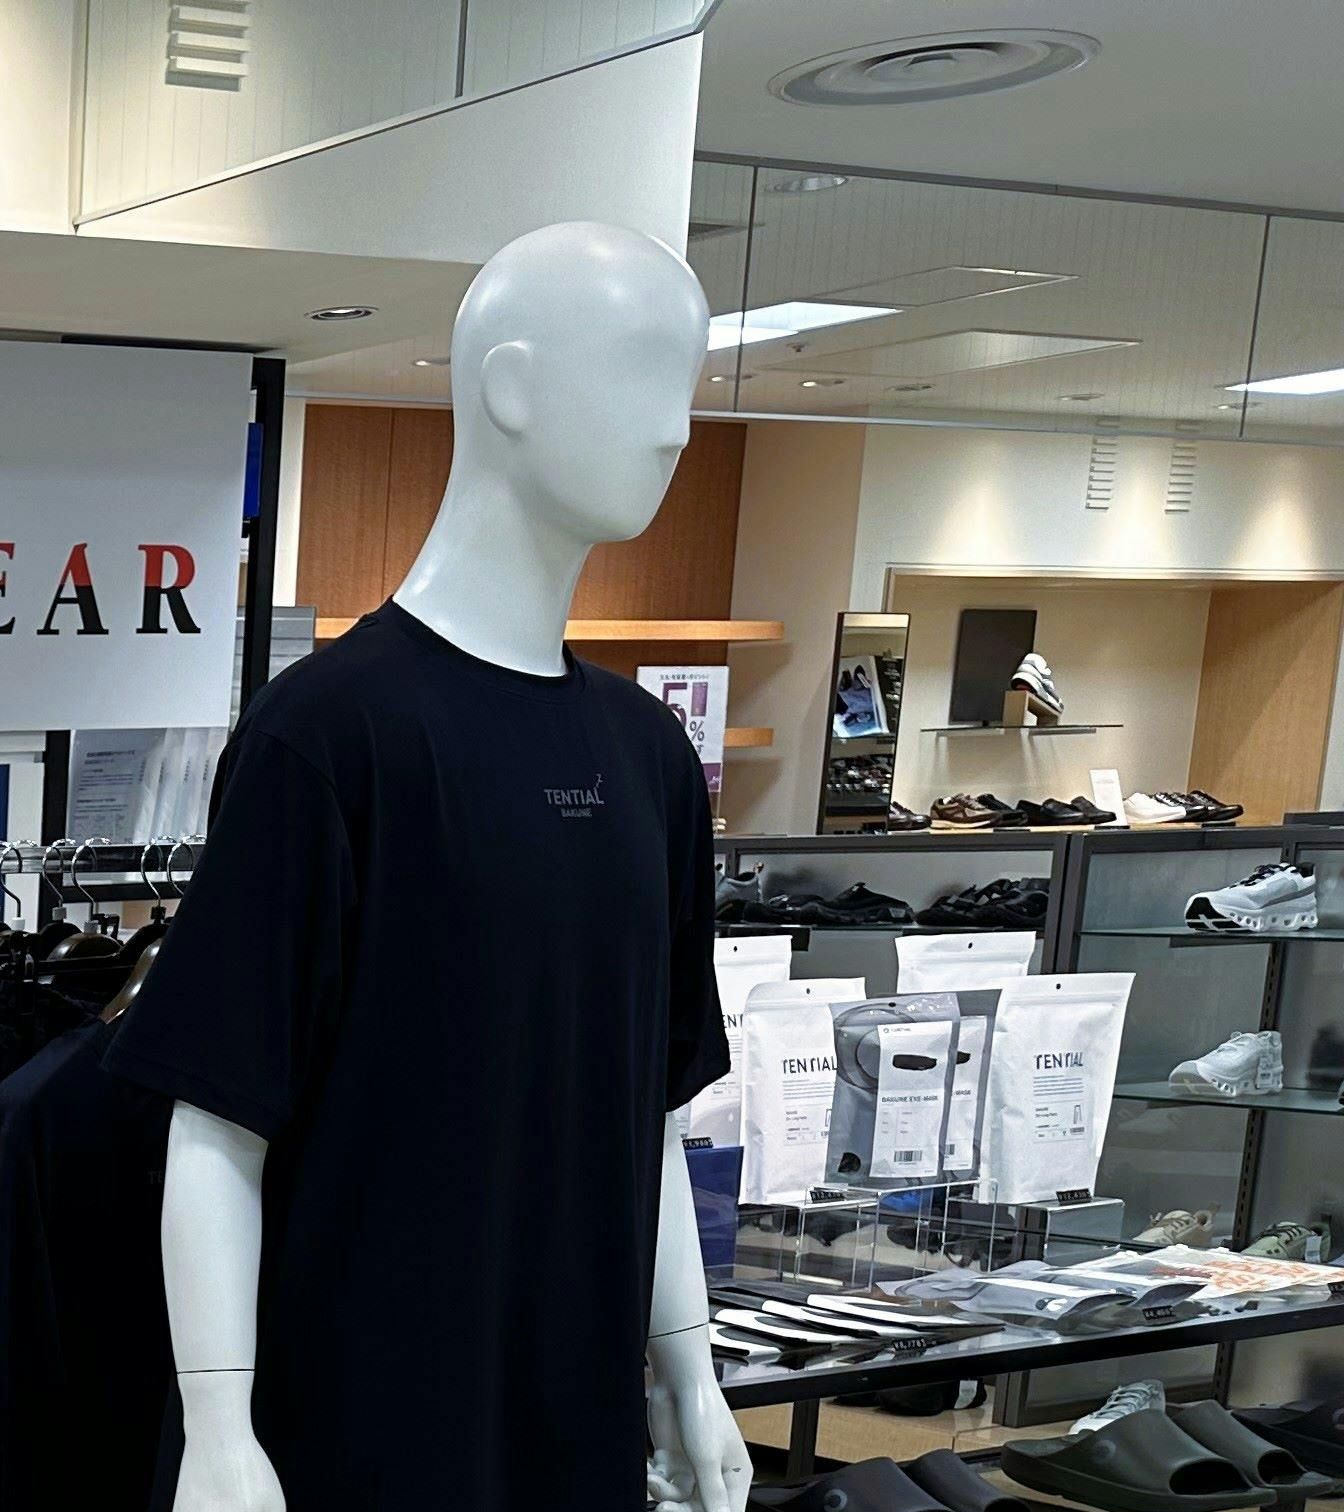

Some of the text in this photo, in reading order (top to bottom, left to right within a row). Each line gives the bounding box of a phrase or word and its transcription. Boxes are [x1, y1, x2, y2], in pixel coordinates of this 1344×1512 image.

[543, 786, 605, 805] TENTIAL
[782, 1056, 838, 1075] TENTIAL
[1034, 1052, 1084, 1070] TENTIAL
